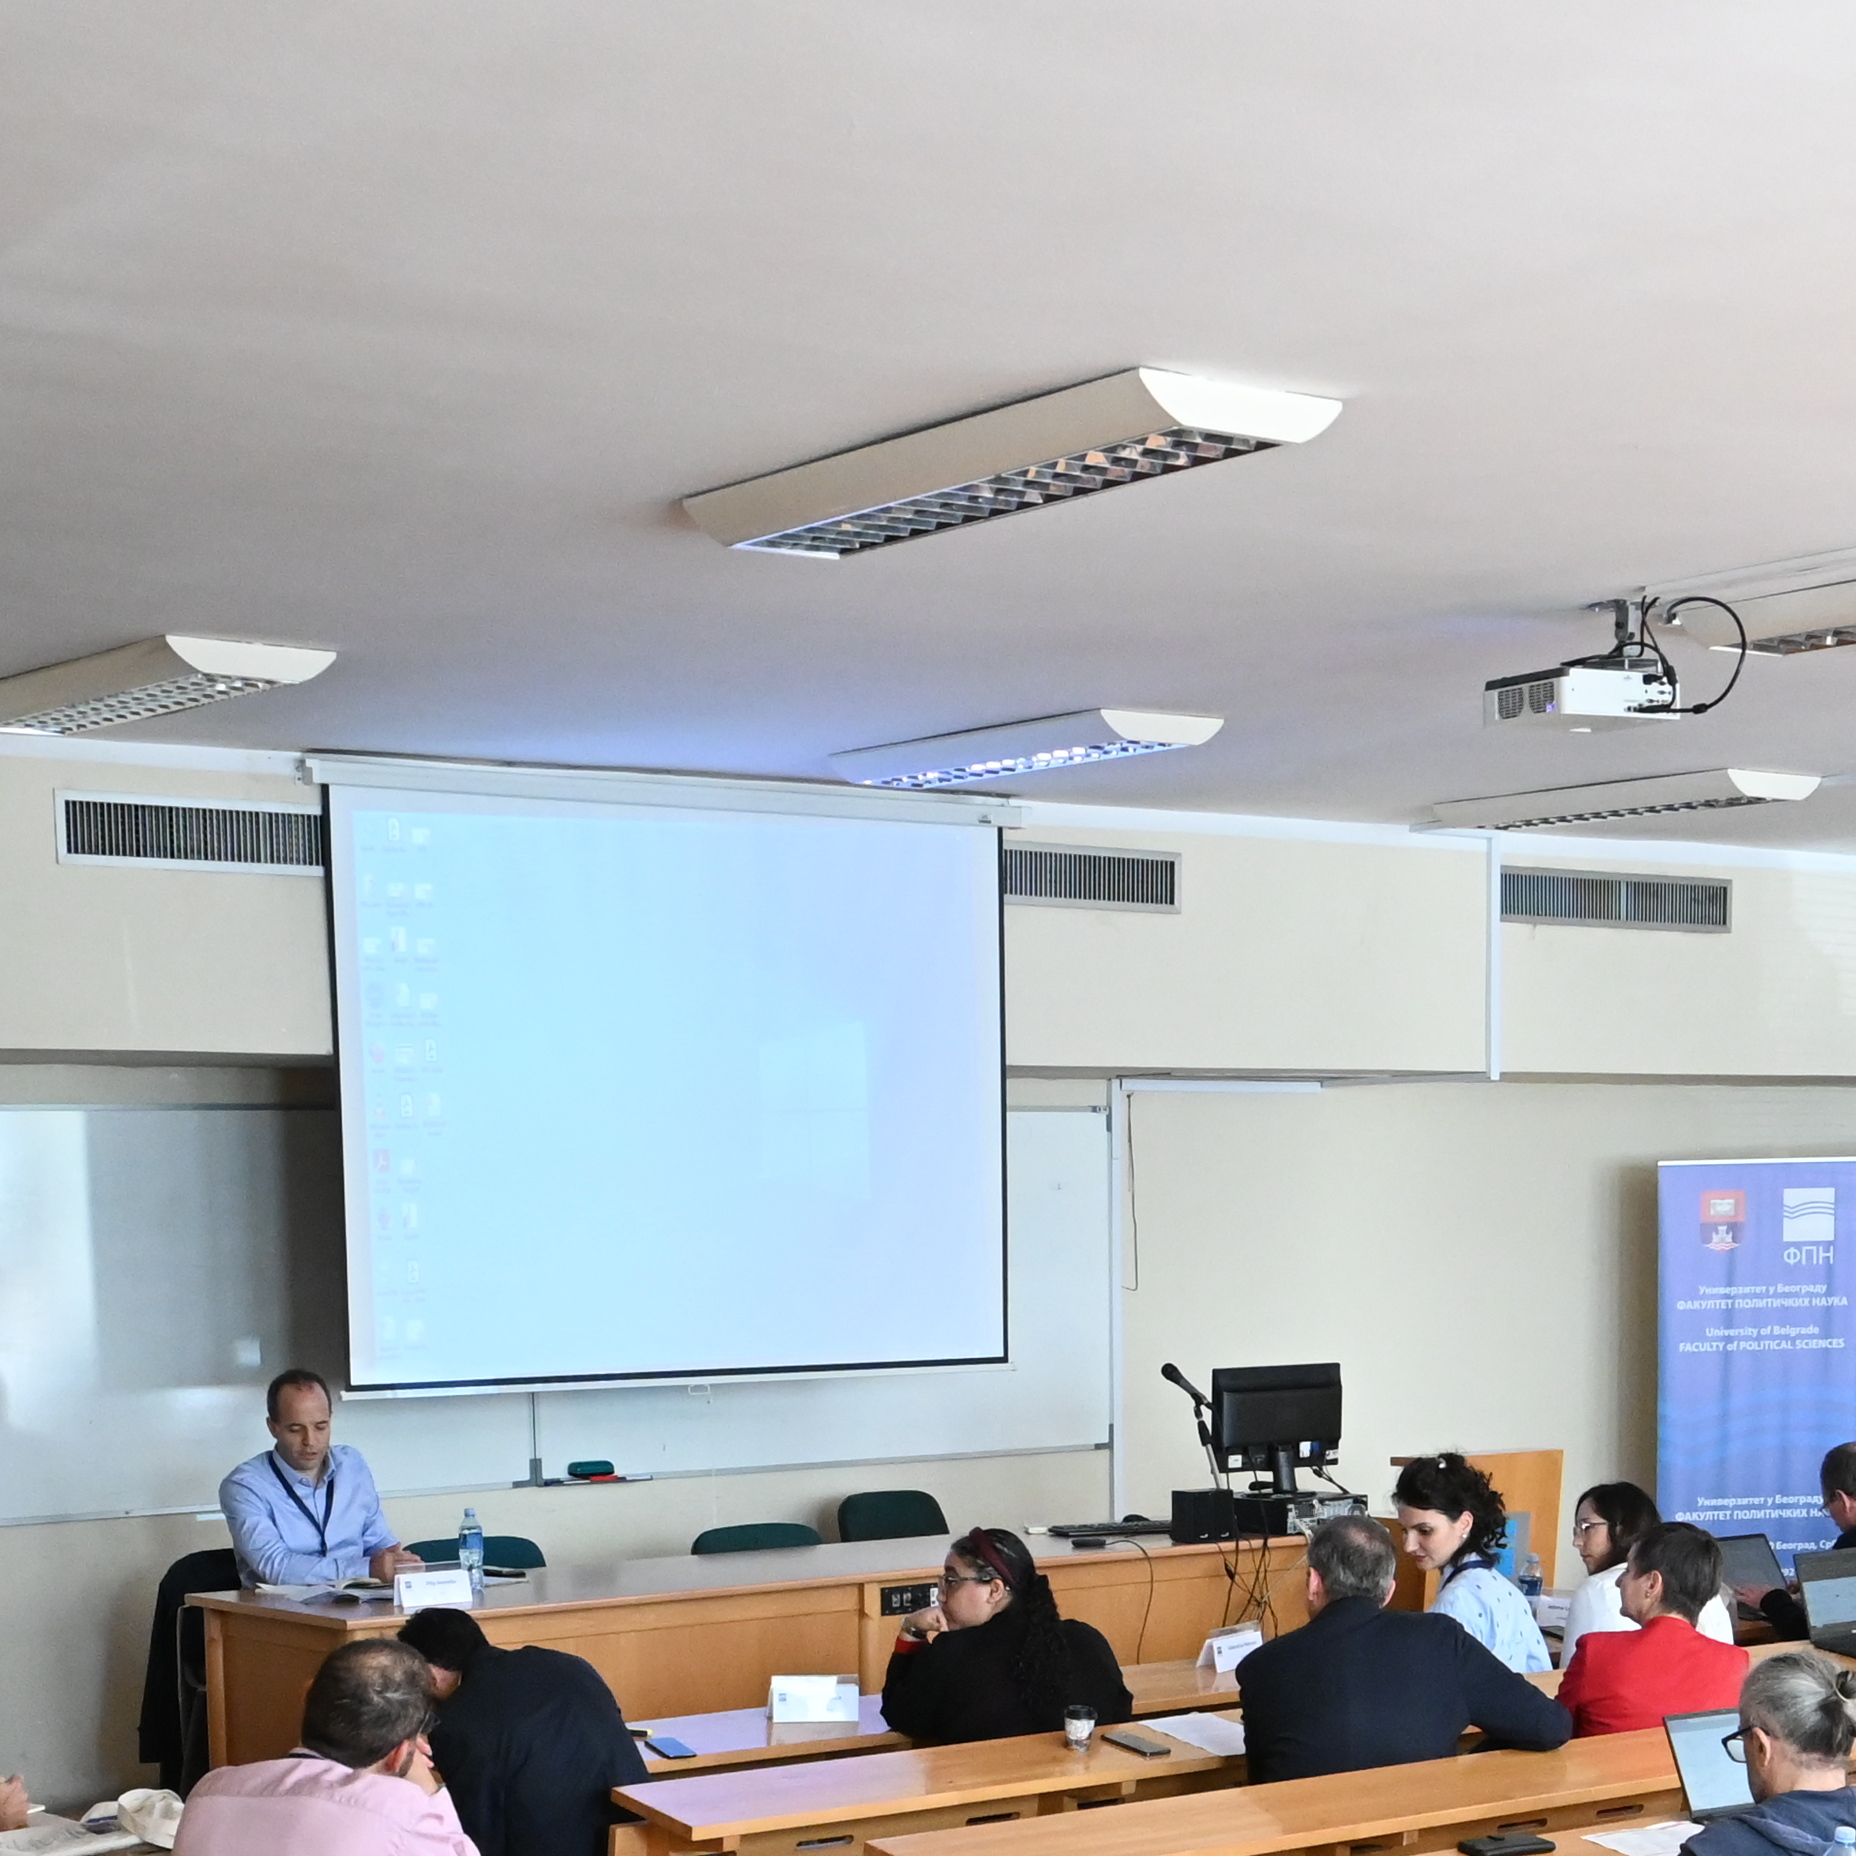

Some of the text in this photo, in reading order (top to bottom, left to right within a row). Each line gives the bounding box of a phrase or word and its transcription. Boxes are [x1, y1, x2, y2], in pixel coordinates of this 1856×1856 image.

[1783, 1245, 1834, 1265] ФПН
[1698, 1285, 1767, 1296] Универзитет
[1777, 1283, 1828, 1294] Београду
[1676, 1296, 1849, 1310] ФАКУЛТЕТ ПОЛИТИЧКИХ НАУКА
[1706, 1324, 1820, 1337] University of Belgrade
[1679, 1342, 1725, 1352] FACULTY
[1739, 1339, 1794, 1350] POLITICAL
[1795, 1338, 1846, 1349] SCIENCES
[1697, 1496, 1765, 1507] Универзитет
[1675, 1511, 1731, 1521] ФАКУЛТЕТ
[1733, 1509, 1808, 1520] ПОЛИТИЧКИХ
[1777, 1540, 1817, 1551] Београд,
